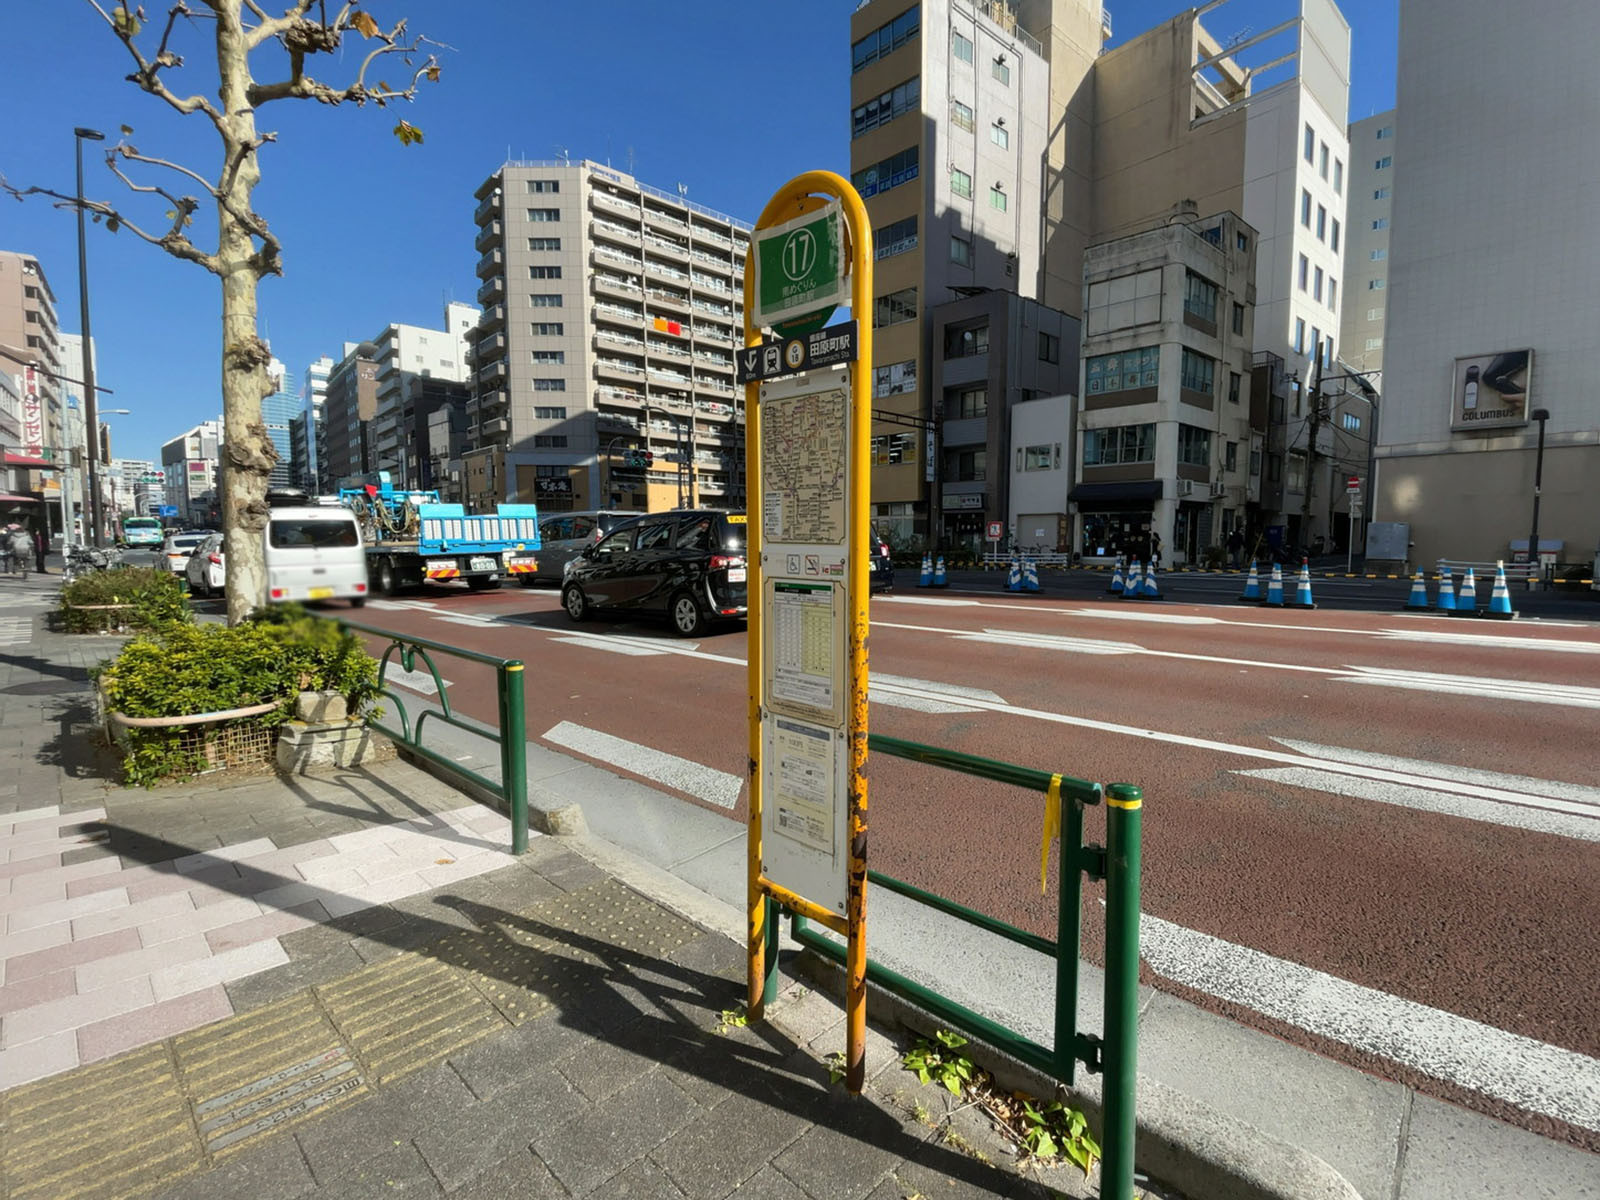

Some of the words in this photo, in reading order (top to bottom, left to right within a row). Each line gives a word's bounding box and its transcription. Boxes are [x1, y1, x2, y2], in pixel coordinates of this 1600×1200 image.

[788, 233, 810, 275] 17
[810, 334, 851, 358] 田原町駅
[1462, 409, 1515, 421] COLUMBUS
